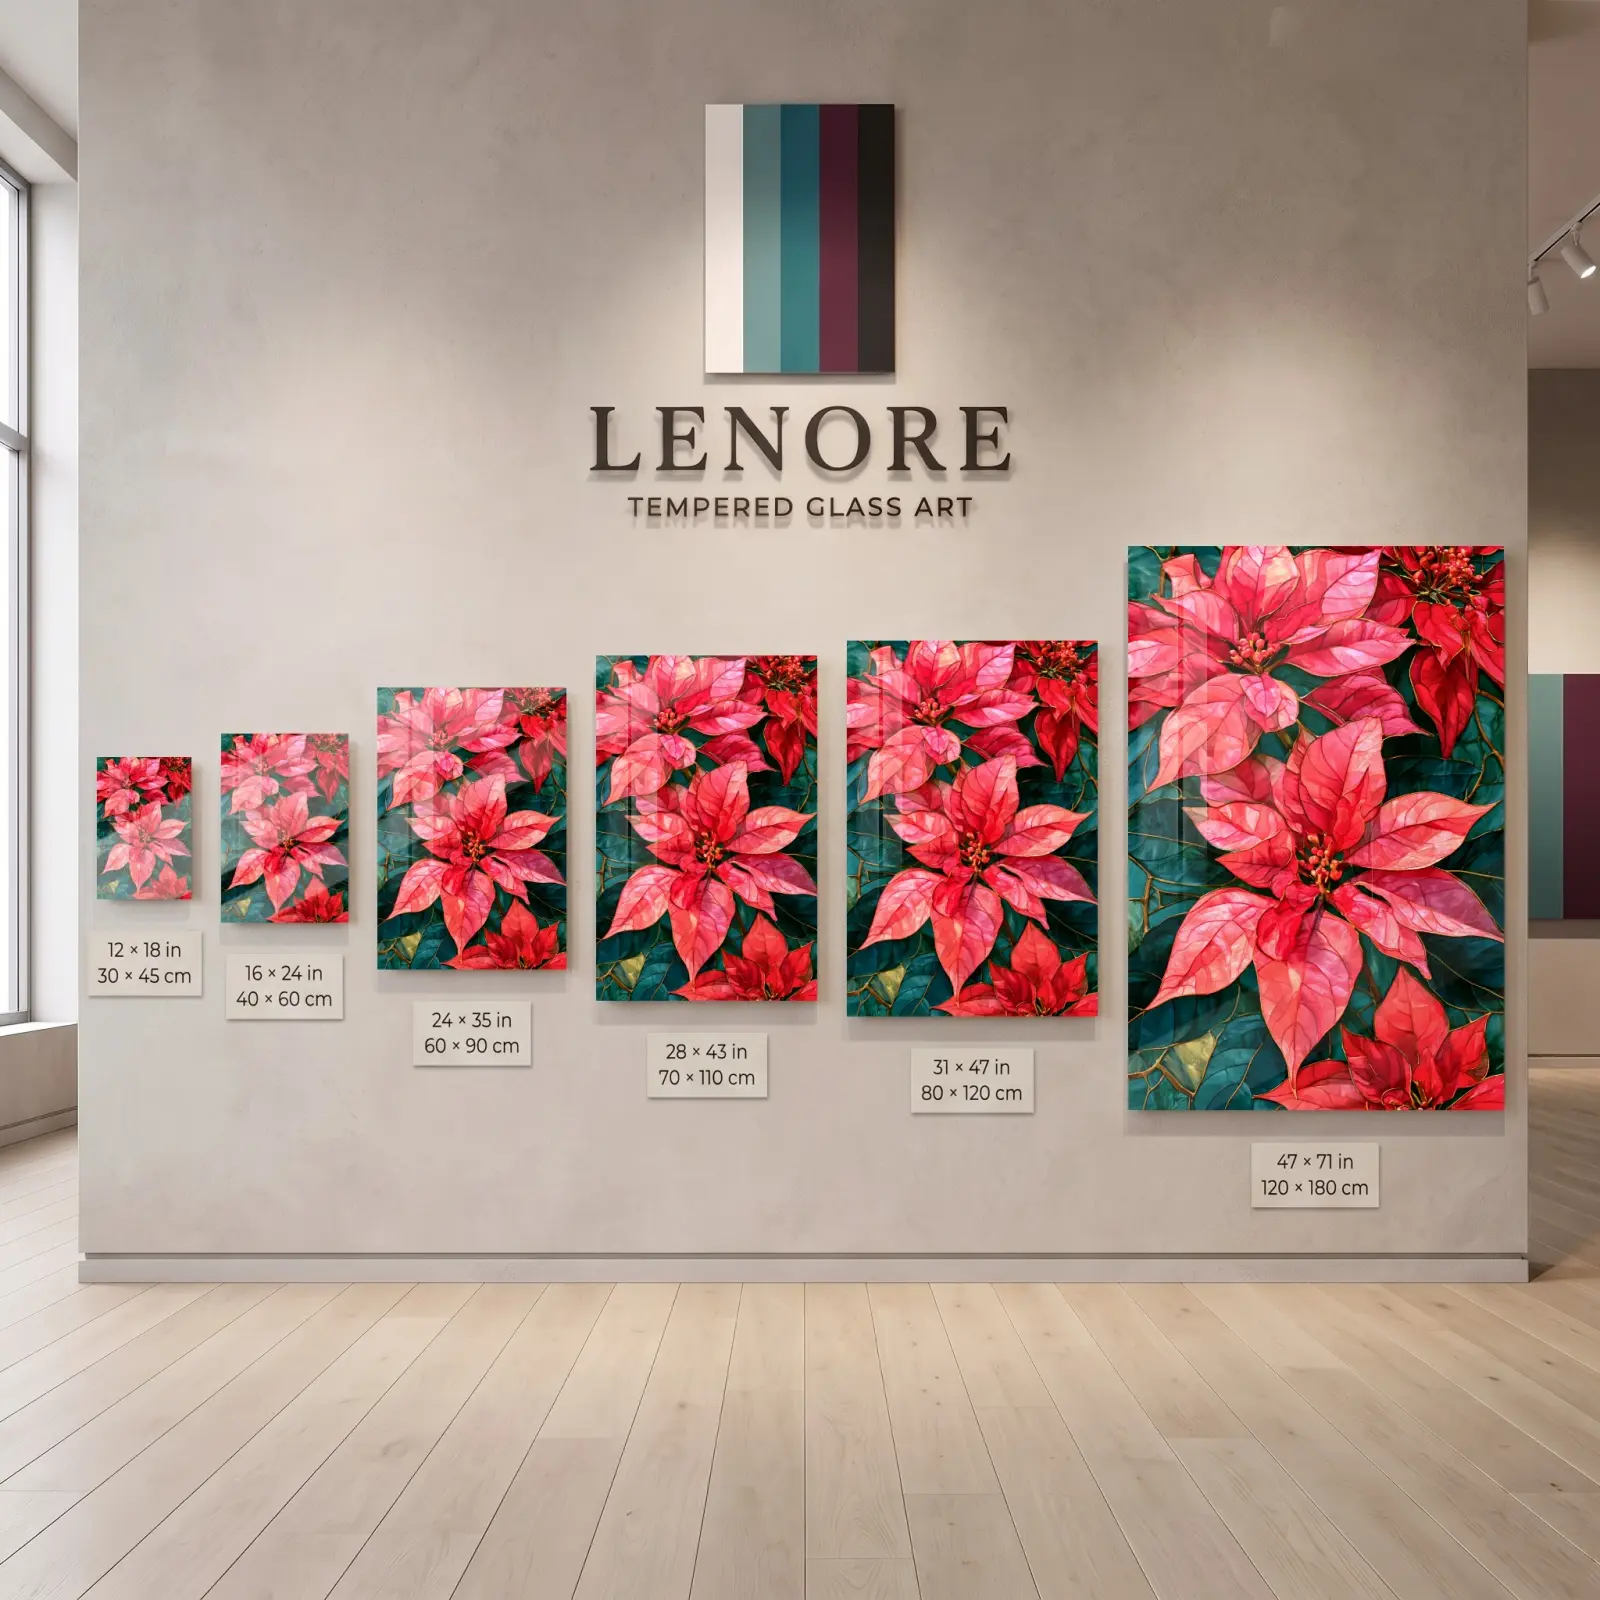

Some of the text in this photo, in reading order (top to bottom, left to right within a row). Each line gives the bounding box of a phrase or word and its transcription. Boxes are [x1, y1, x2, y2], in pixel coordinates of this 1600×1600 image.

[589, 405, 1011, 472] LENORE
[627, 496, 973, 518] TEMPERED GLASS ART
[107, 941, 124, 958] 12
[143, 941, 161, 958] 18
[166, 941, 181, 958] in
[97, 967, 119, 984] 30
[138, 967, 160, 984] 45
[164, 971, 192, 984] cm
[245, 965, 263, 981] 16
[281, 965, 303, 981] 24
[307, 964, 323, 981] in
[236, 990, 259, 1007] 40
[278, 990, 300, 1007] 60
[304, 994, 332, 1007] cm
[431, 1012, 453, 1028] 24
[471, 1011, 492, 1028] 35
[496, 1011, 512, 1028] in
[424, 1037, 447, 1054] 60
[465, 1037, 488, 1054] 90
[492, 1041, 520, 1054] cm
[665, 1043, 687, 1060] 28
[705, 1043, 727, 1060] 43
[732, 1043, 748, 1060] in
[933, 1059, 949, 1075] 31
[968, 1059, 990, 1075] 47
[995, 1058, 1010, 1075] in
[658, 1069, 680, 1086] 70
[698, 1069, 724, 1086] 110
[728, 1072, 755, 1086] cm
[921, 1084, 944, 1101] 80
[962, 1084, 991, 1101] 120
[995, 1088, 1022, 1101] cm
[1276, 1153, 1298, 1170] 47
[1316, 1153, 1332, 1170] 71
[1338, 1152, 1354, 1170] in
[1261, 1179, 1289, 1196] 120
[1308, 1179, 1337, 1196] 180
[1341, 1182, 1369, 1196] cm
